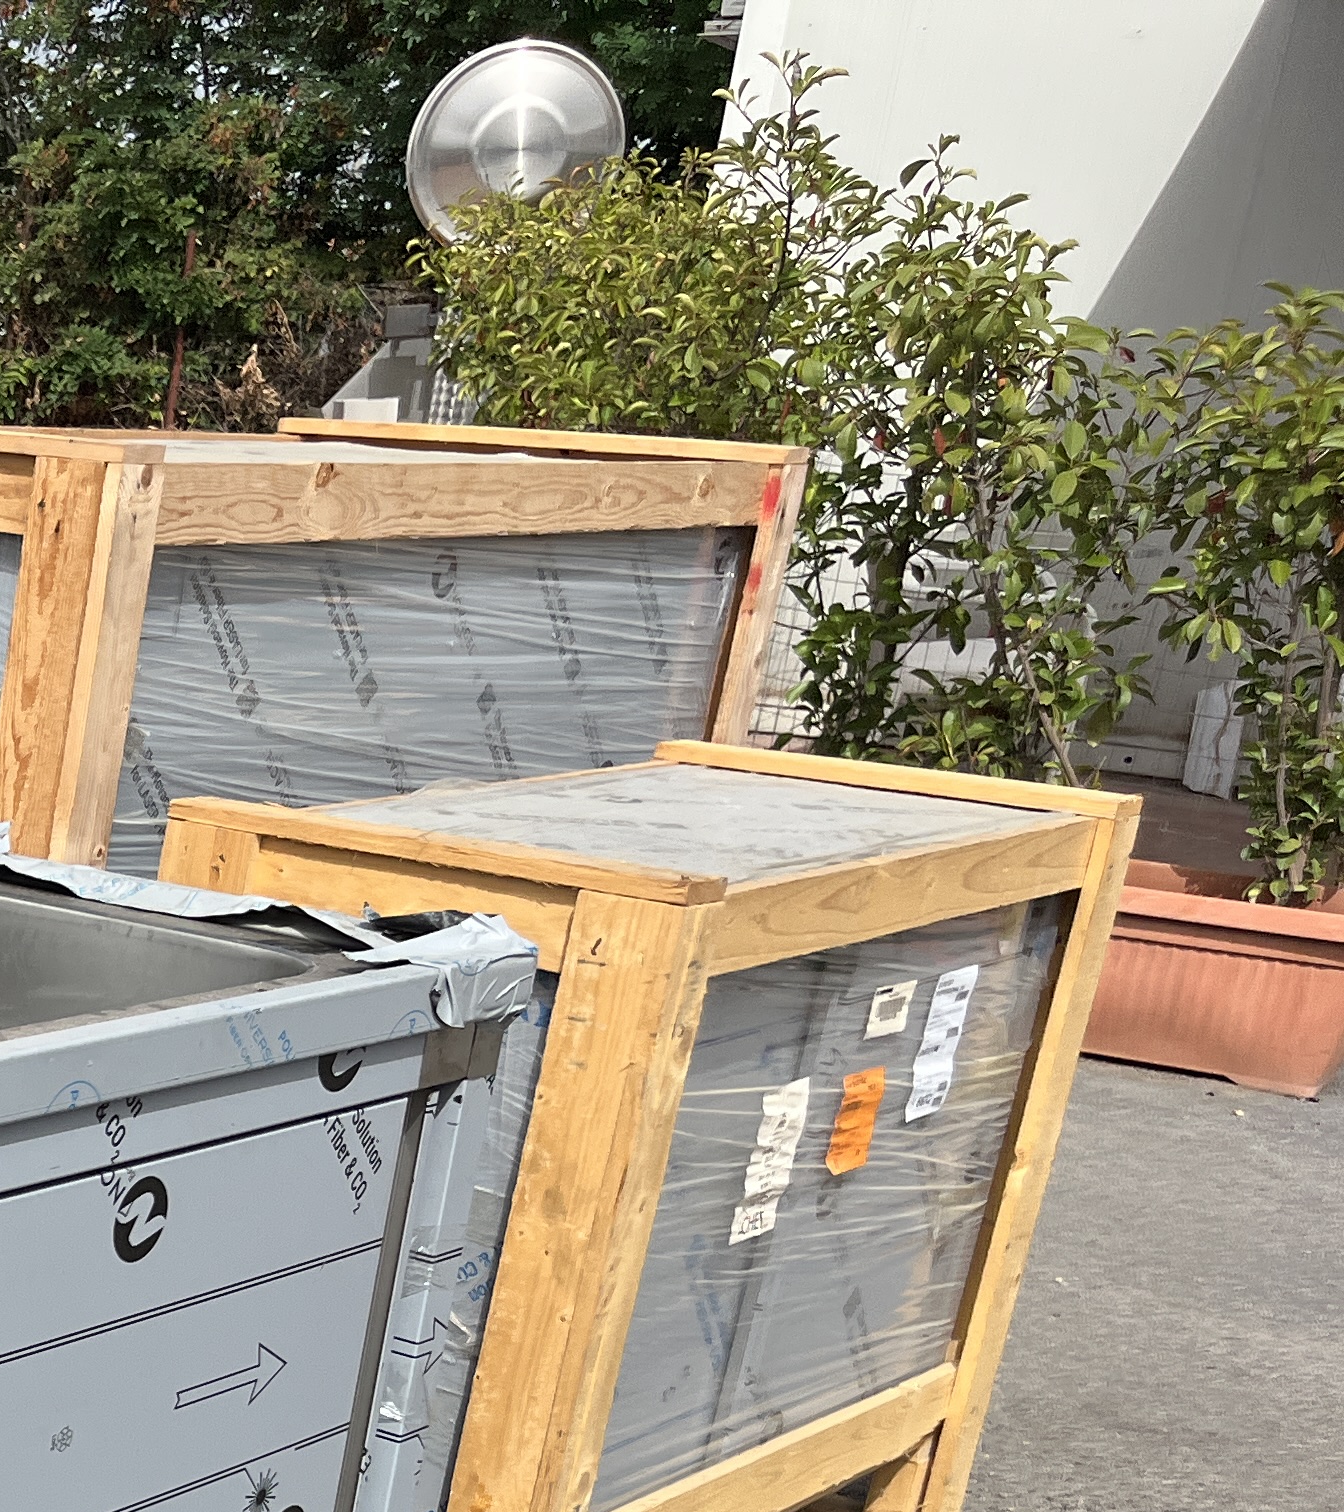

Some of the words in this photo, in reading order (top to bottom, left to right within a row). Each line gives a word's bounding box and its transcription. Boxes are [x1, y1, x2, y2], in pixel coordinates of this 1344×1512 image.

[327, 1116, 352, 1162] Fiber
[345, 1156, 358, 1178] &
[351, 1108, 383, 1175] Solution
